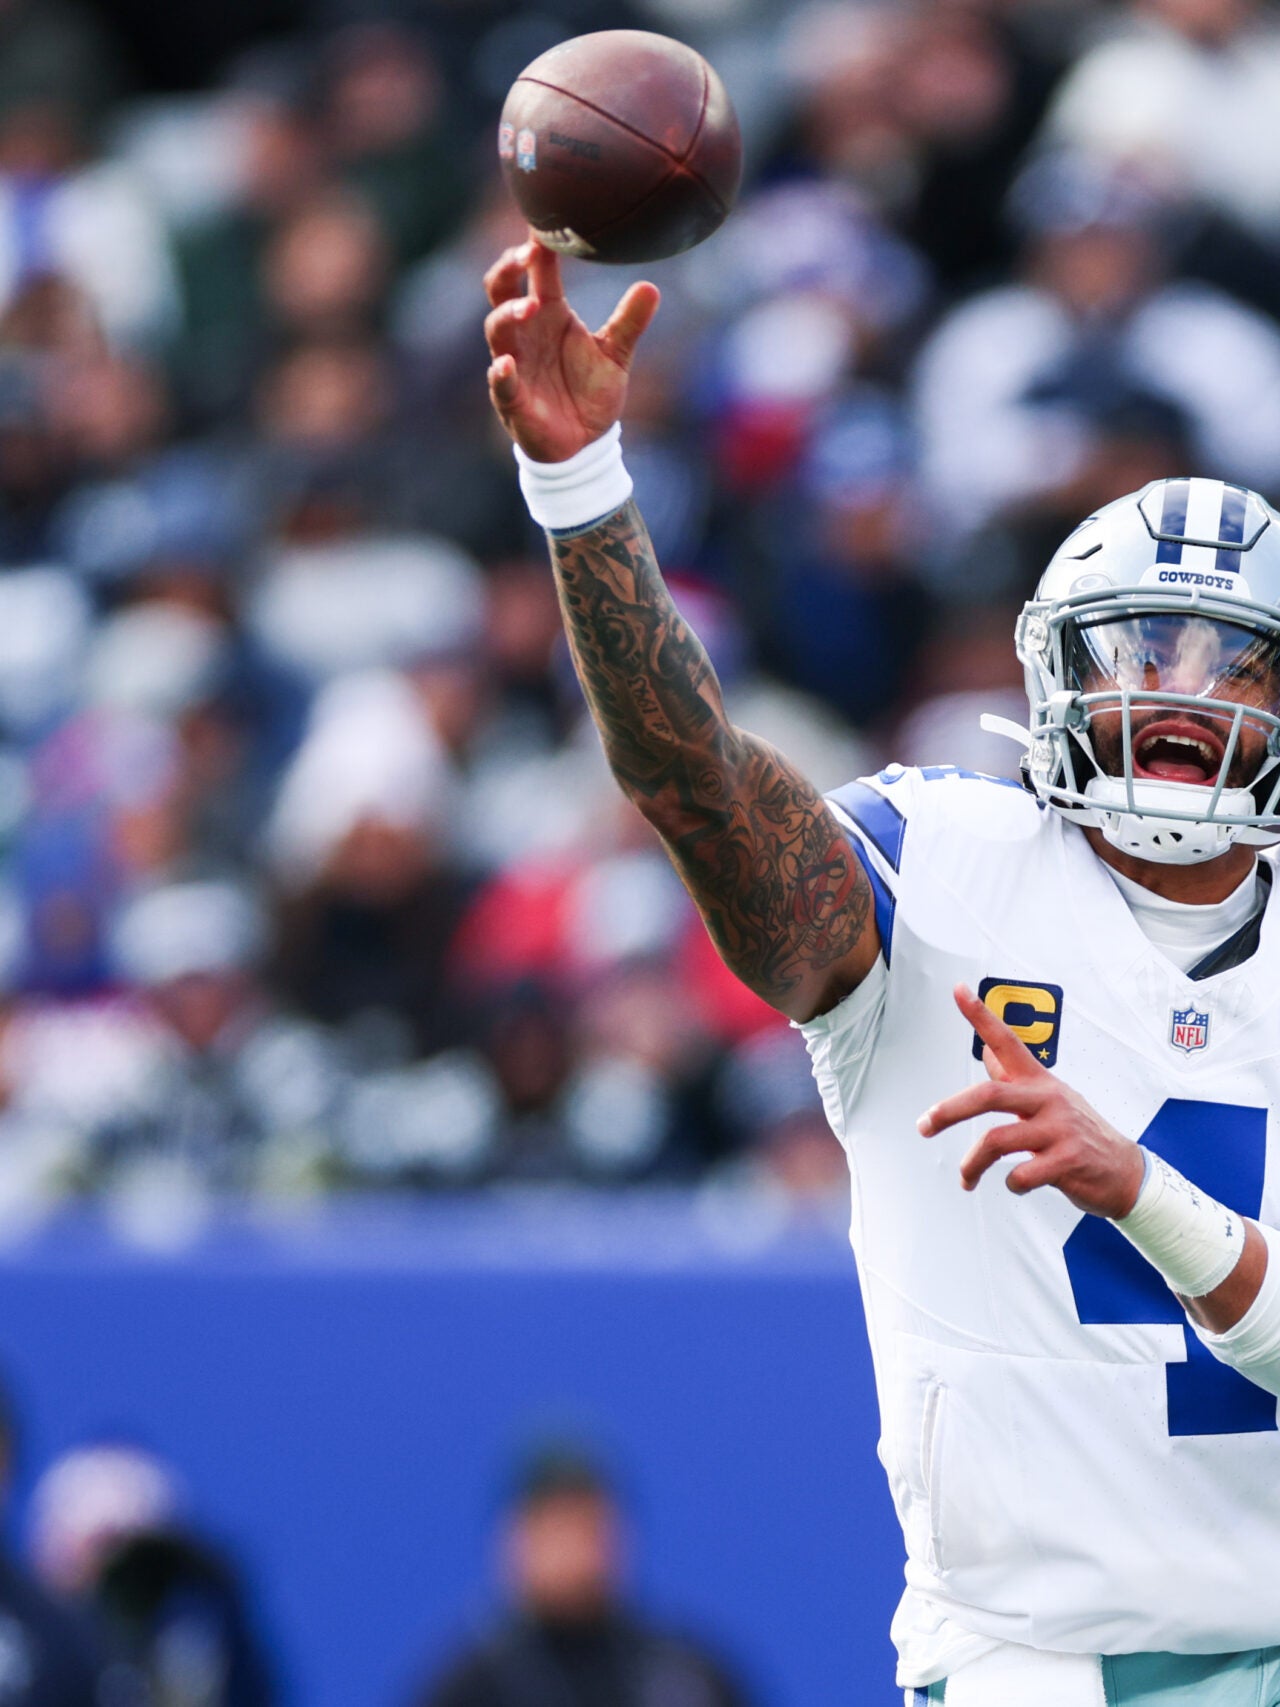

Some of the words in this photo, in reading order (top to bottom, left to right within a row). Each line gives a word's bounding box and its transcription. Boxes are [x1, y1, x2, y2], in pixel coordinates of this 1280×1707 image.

[1158, 570, 1235, 591] COWBOYS
[984, 984, 1057, 1045] C
[1174, 1025, 1204, 1047] NFL
[1062, 1097, 1279, 1437] 4
